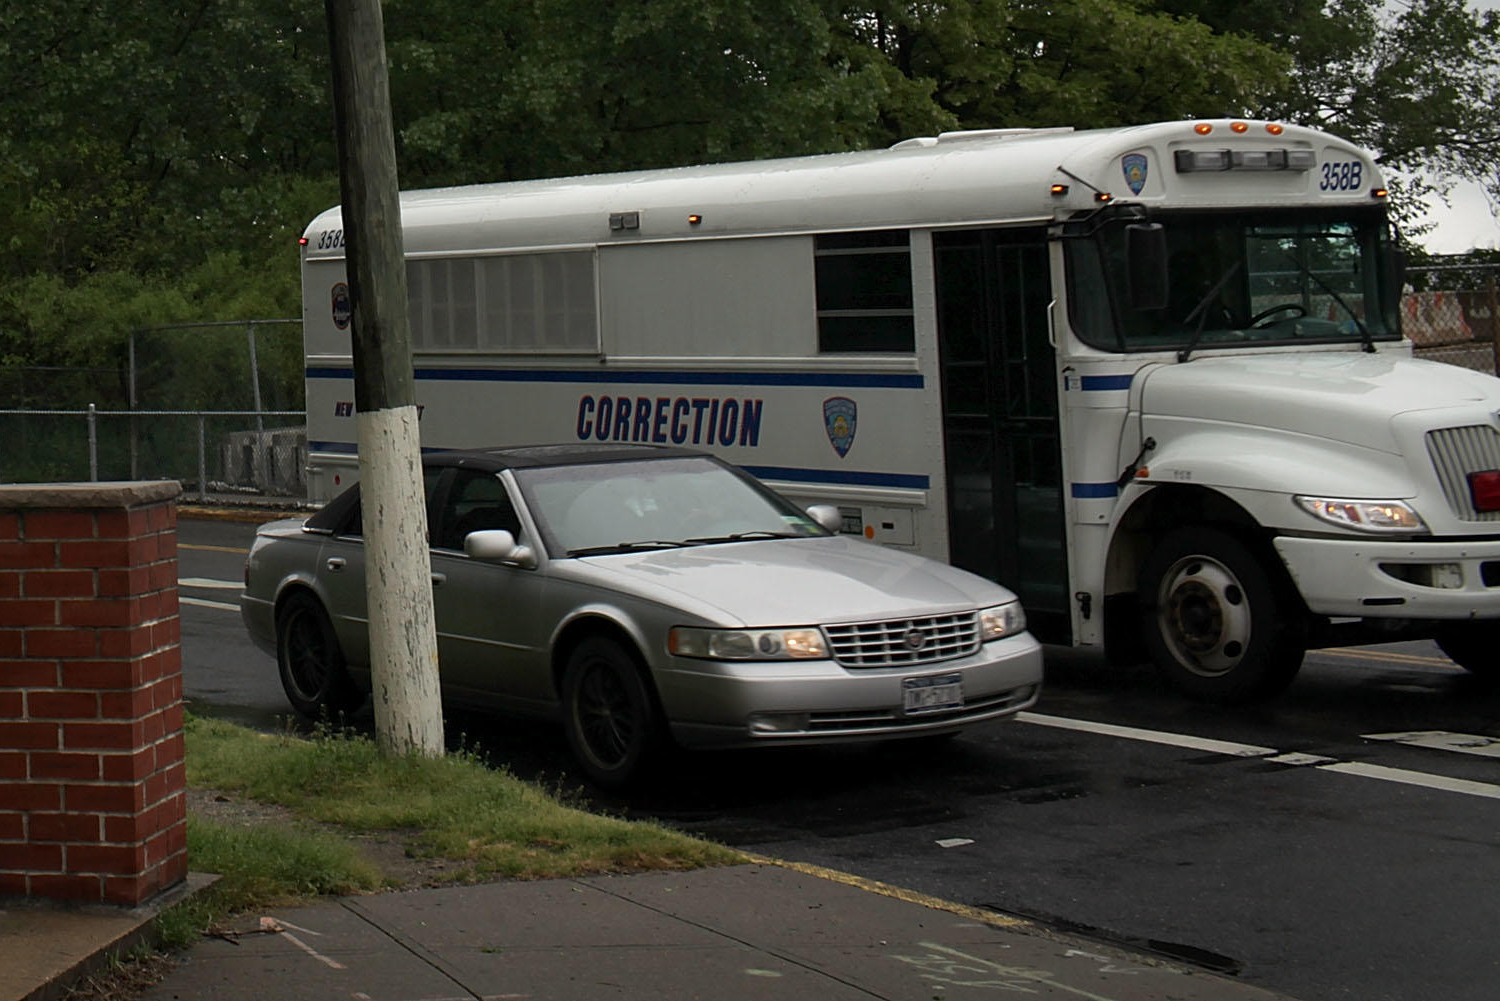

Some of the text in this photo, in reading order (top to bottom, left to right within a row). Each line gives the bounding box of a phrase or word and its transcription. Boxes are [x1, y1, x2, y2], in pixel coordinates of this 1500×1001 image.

[1319, 160, 1363, 191] 358B
[334, 401, 353, 417] NEW
[576, 394, 763, 447] CORRECTION
